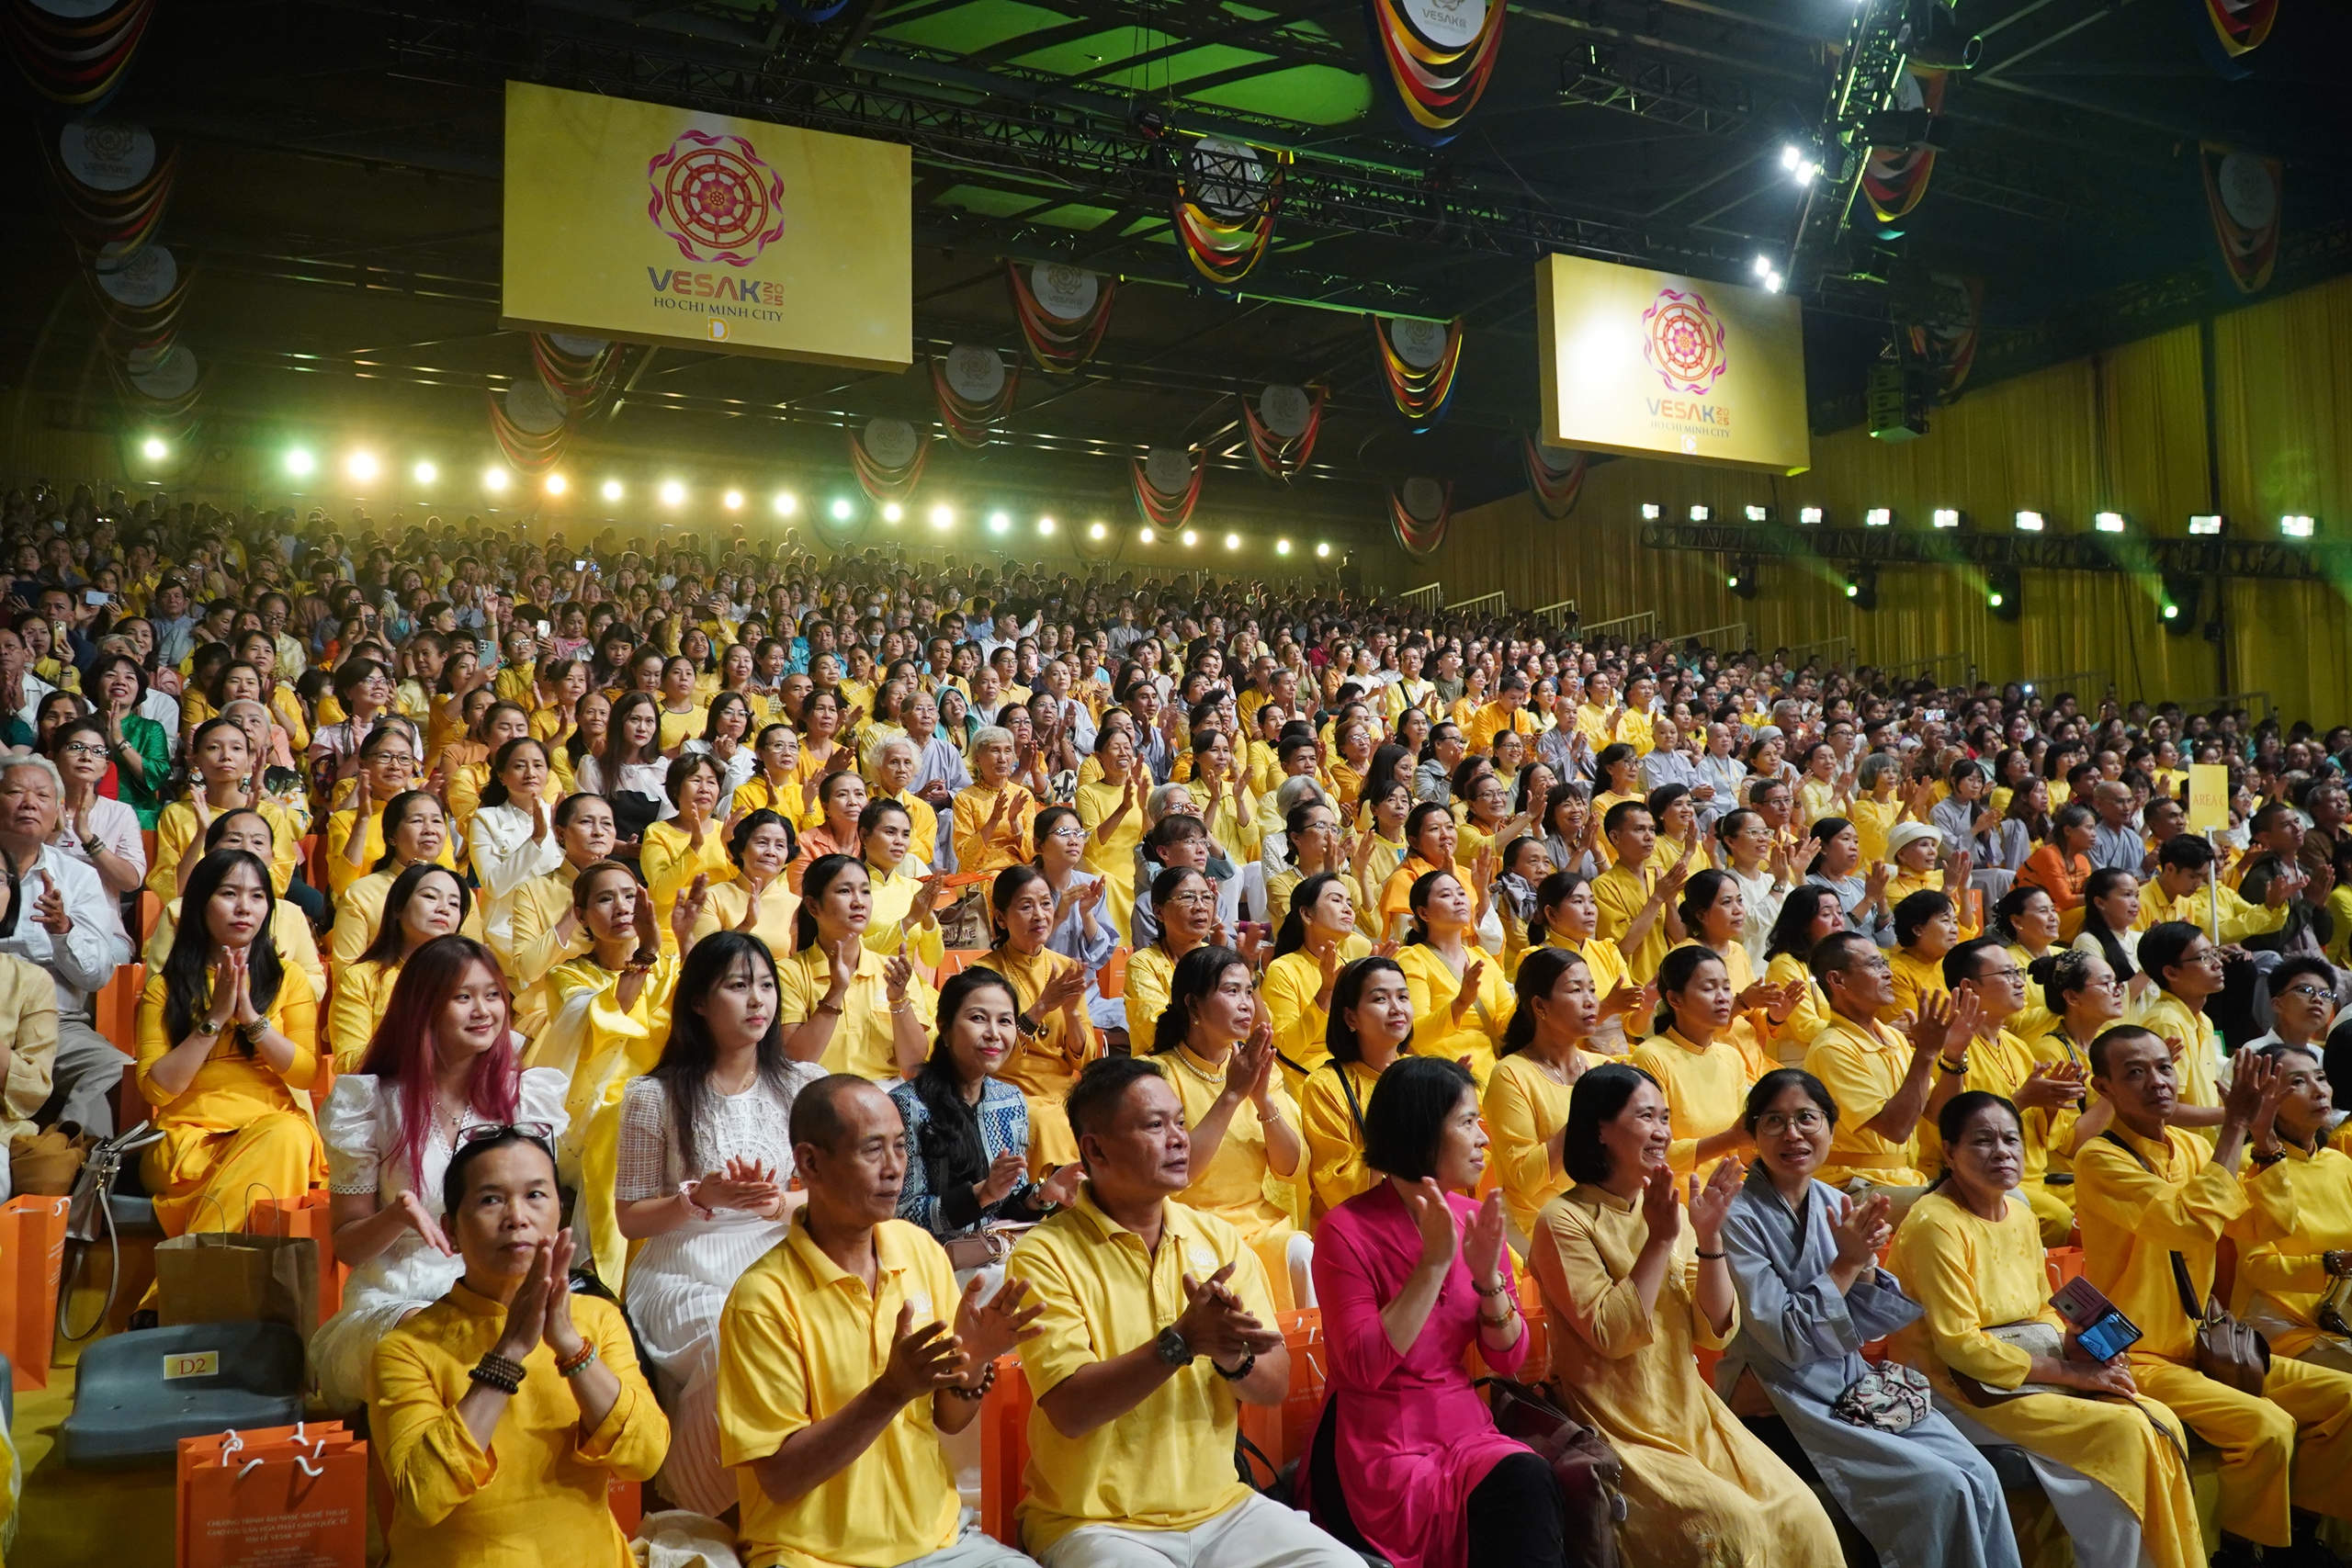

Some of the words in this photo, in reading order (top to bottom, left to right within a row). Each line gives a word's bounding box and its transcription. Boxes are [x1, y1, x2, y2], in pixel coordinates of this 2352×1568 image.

[1422, 7, 1458, 27] VESAK
[647, 266, 761, 303] VESAK
[654, 297, 676, 309] HO
[678, 299, 704, 312] CHI
[709, 304, 748, 318] MINH
[752, 309, 784, 321] CITY
[708, 317, 729, 342] D
[1645, 397, 1715, 423] VESAK
[1651, 420, 1665, 429] HO
[1666, 422, 1682, 432] CHI
[1684, 425, 1709, 435] MINH
[1711, 428, 1731, 438] CITY
[1683, 435, 1696, 453] C
[2192, 795, 2217, 807] AREA
[2219, 795, 2227, 807] C
[180, 1359, 206, 1374] D2
